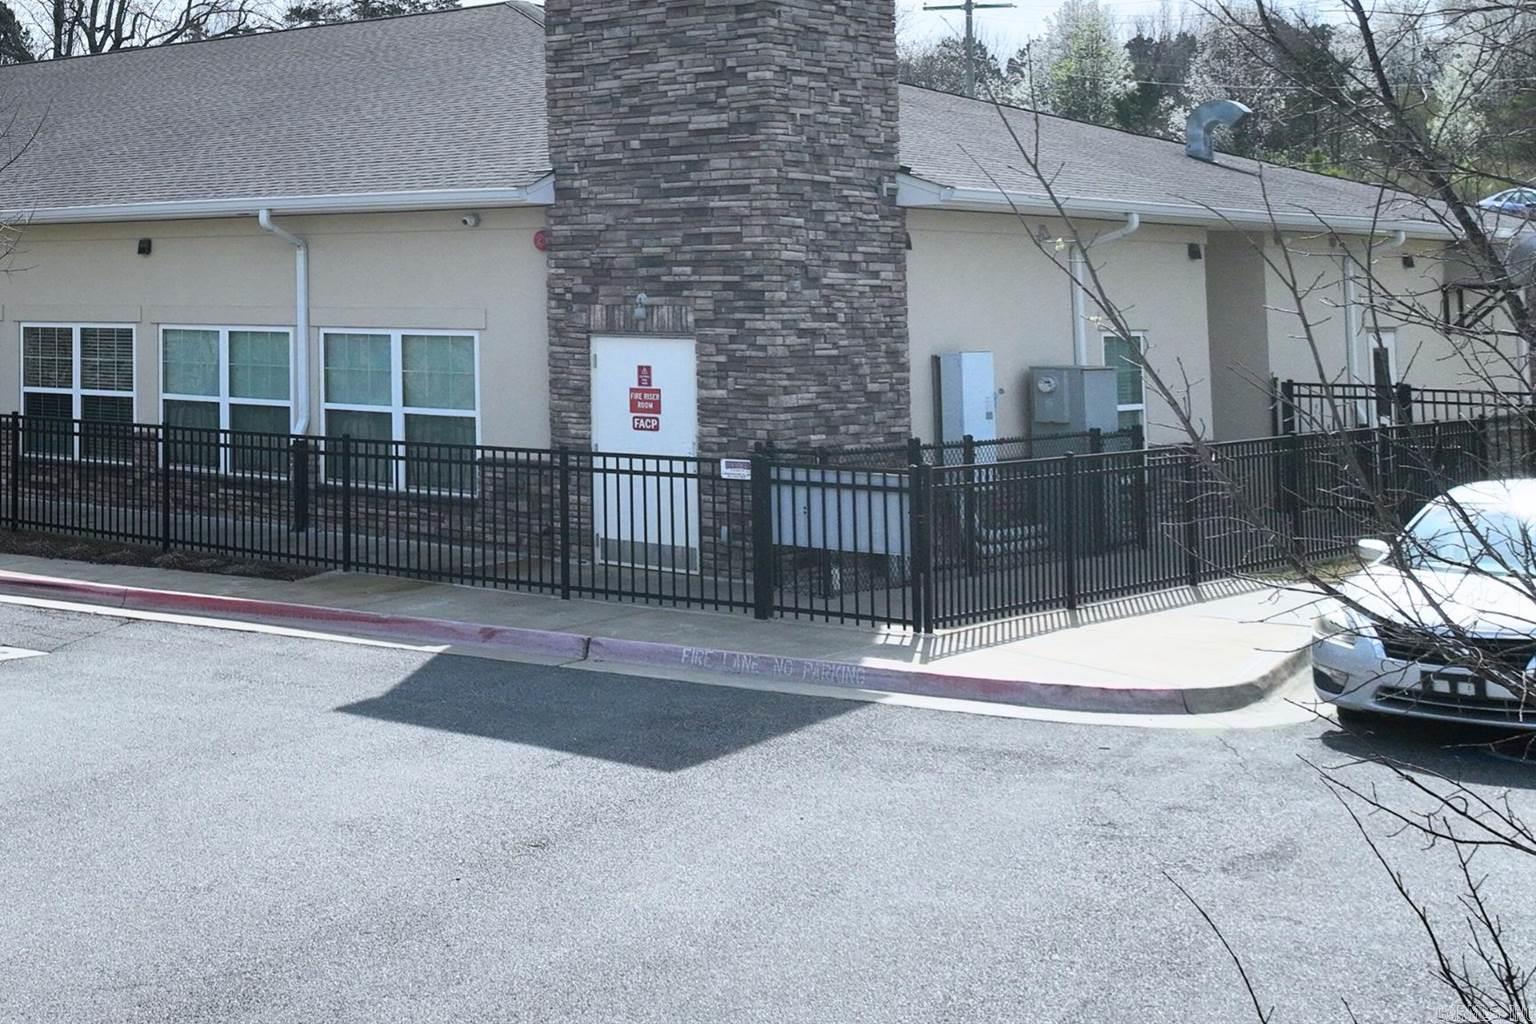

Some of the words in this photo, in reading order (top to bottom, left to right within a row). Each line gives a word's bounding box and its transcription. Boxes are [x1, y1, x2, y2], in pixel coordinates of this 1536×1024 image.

[630, 392, 643, 400] FIRE
[637, 401, 654, 409] ROOM
[634, 418, 658, 429] FACP
[681, 647, 713, 669] FIRE
[722, 650, 760, 673] LANE
[774, 658, 793, 676] NO
[802, 660, 865, 685] PARKING
